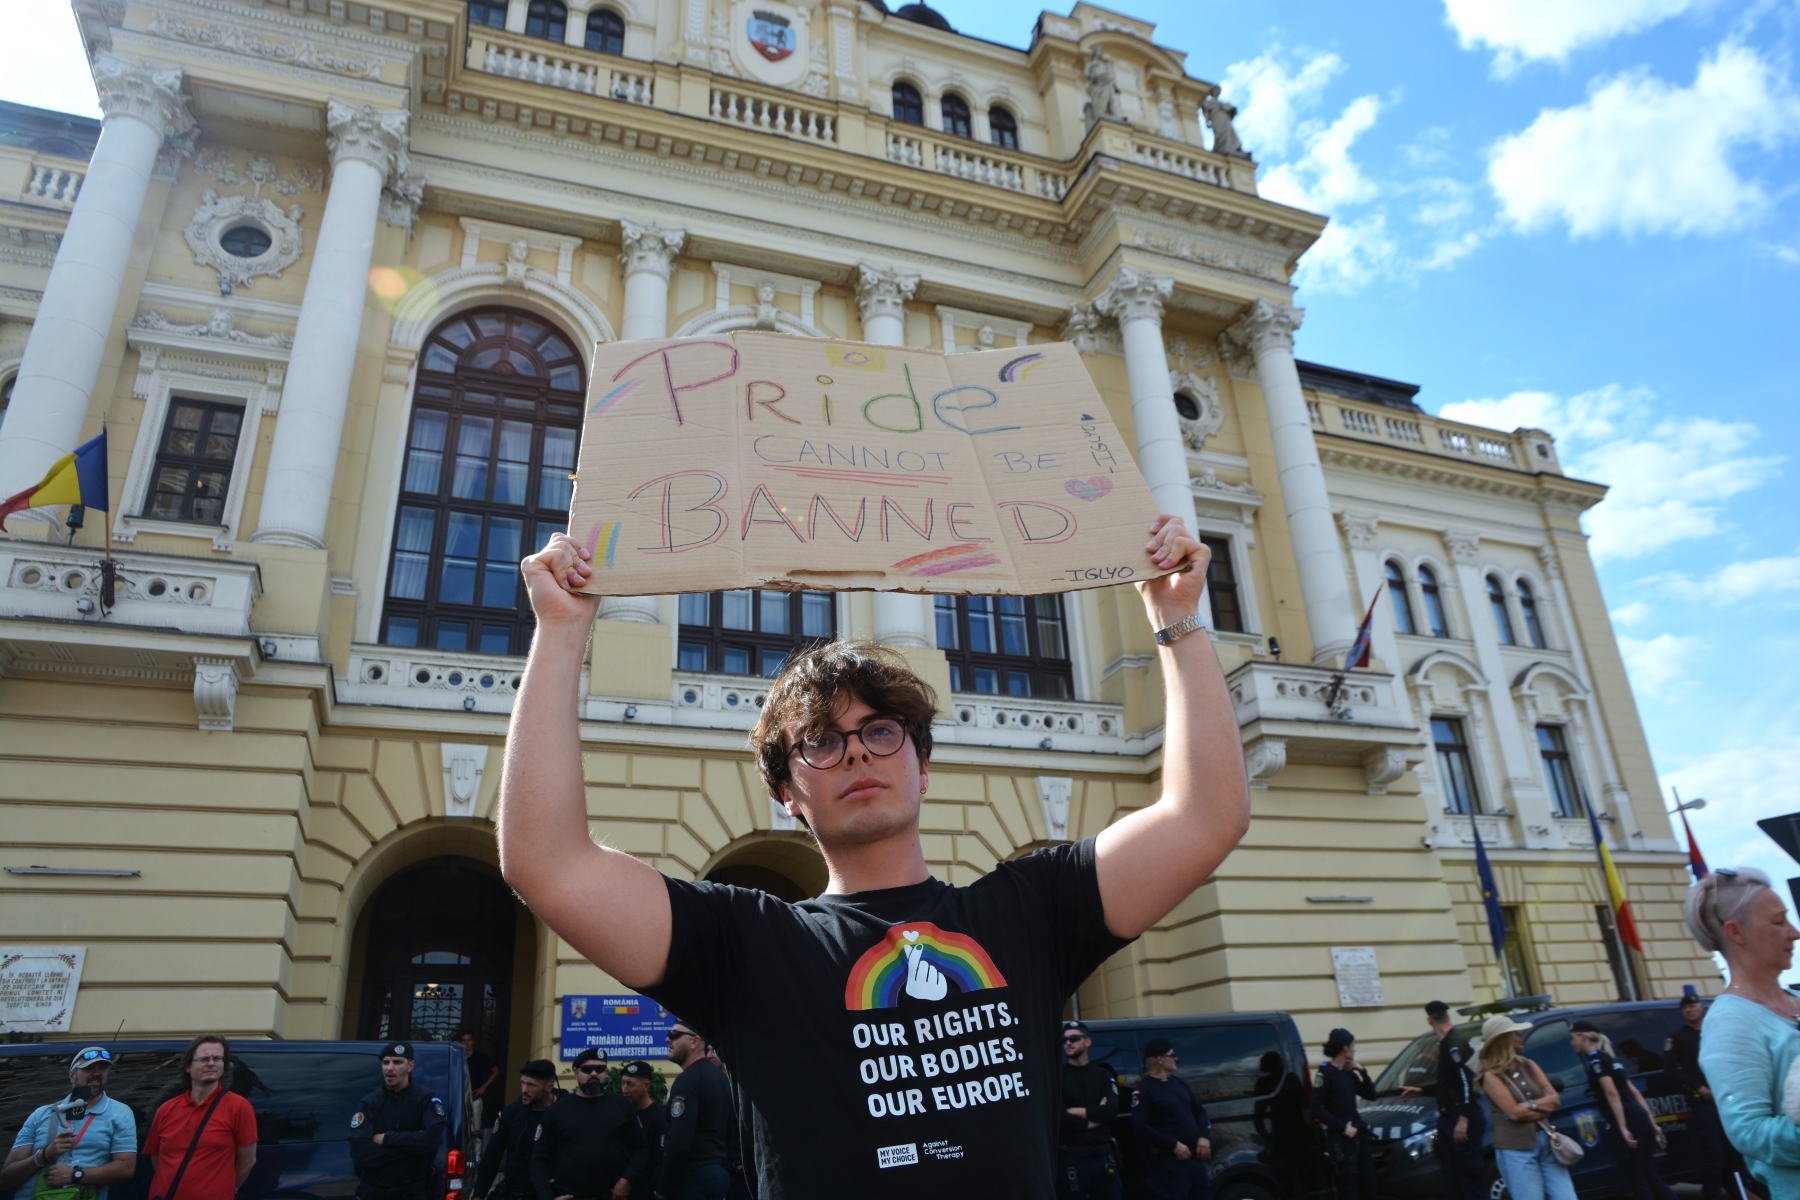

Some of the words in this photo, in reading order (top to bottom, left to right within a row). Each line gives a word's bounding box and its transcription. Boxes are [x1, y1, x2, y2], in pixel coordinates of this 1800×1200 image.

[753, 435, 950, 471] CANNOT
[994, 451, 1067, 473] BE
[616, 470, 1078, 555] BANNED
[853, 1023, 909, 1048] OUR
[914, 1002, 1019, 1044] RIGHTS.
[586, 1034, 623, 1046] PRIMĂRIA
[625, 1035, 653, 1045] ORADEA
[860, 1055, 918, 1084] OUR
[920, 1037, 1024, 1078] BODIES.
[867, 1089, 927, 1118] OUR
[931, 1072, 1030, 1111] EUROPE.
[922, 1139, 948, 1150] Against
[924, 1145, 963, 1155] Conversion
[880, 1149, 890, 1158] MY
[891, 1147, 910, 1156] VOICE
[936, 1151, 964, 1160] Therapy
[881, 1157, 891, 1166] MY
[892, 1153, 916, 1164] CHOICE
